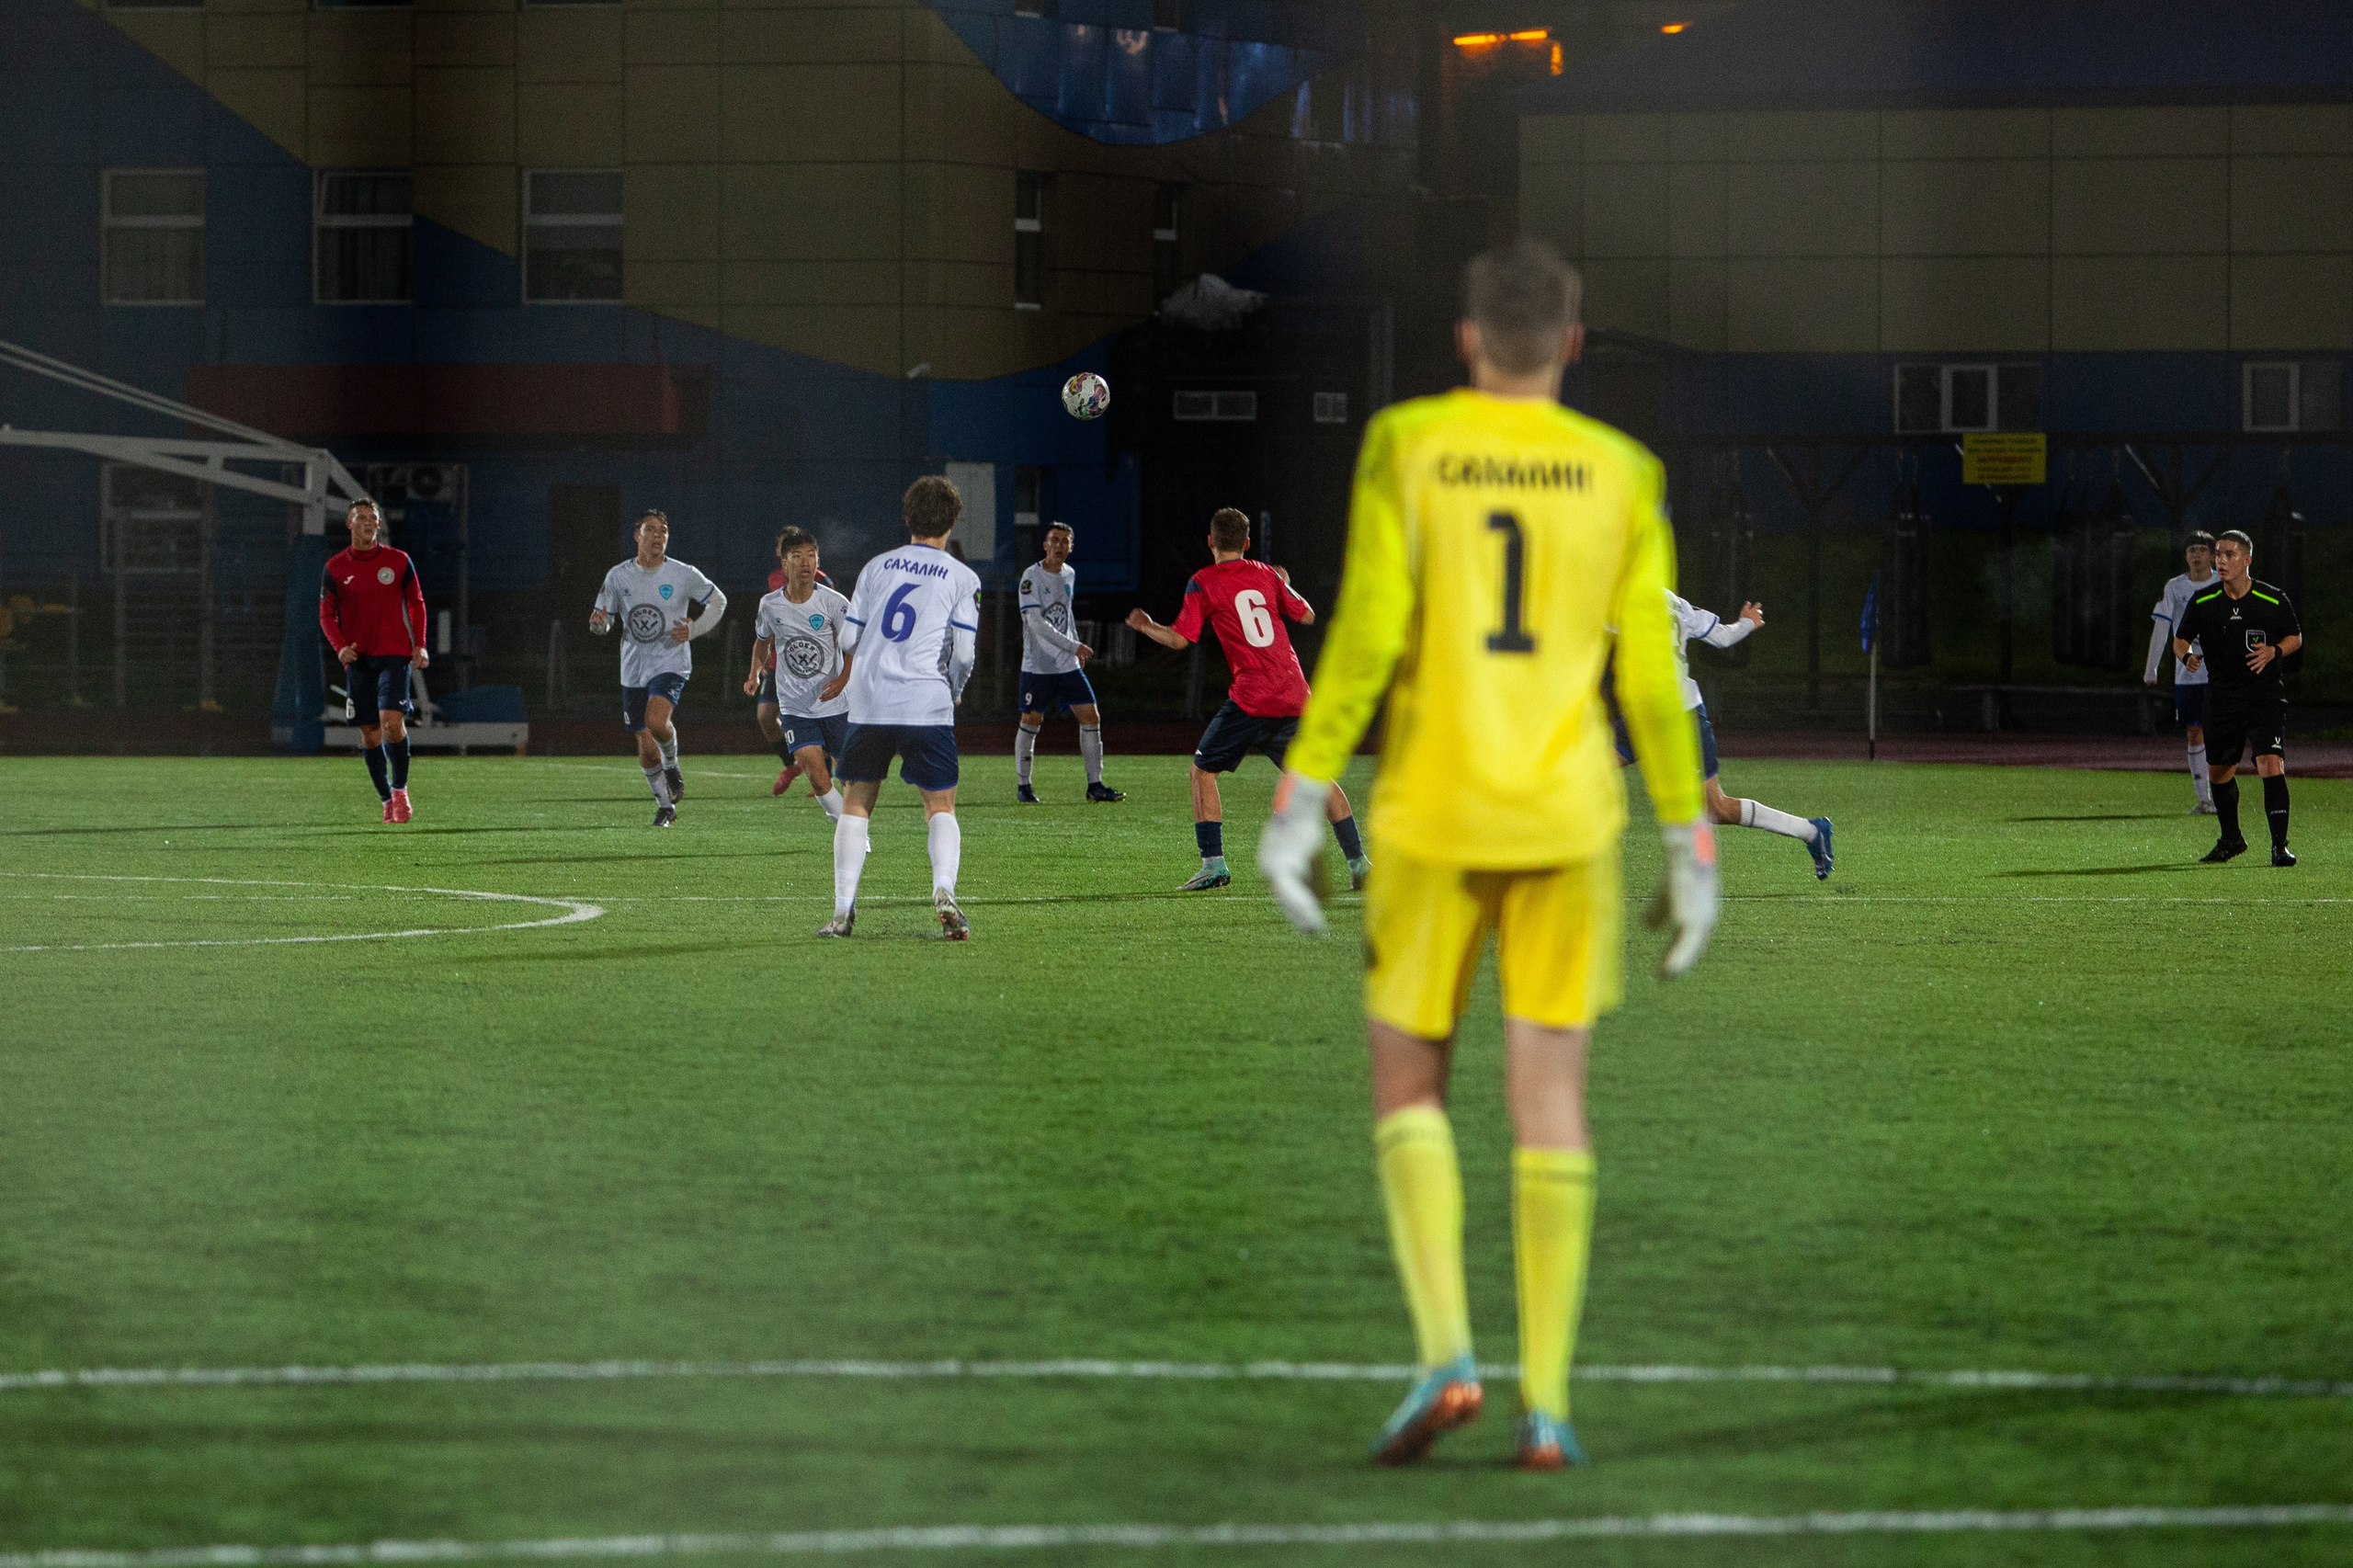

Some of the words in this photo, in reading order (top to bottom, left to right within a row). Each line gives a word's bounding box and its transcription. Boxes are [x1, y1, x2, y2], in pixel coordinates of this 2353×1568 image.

[884, 558, 949, 579] САХАЛИН
[1486, 511, 1536, 653] 1
[633, 608, 658, 619] OLDER
[881, 582, 922, 642] 6
[1234, 588, 1275, 648] 6
[790, 642, 815, 652] OLDER
[346, 698, 356, 720] 6
[1025, 692, 1032, 706] 9
